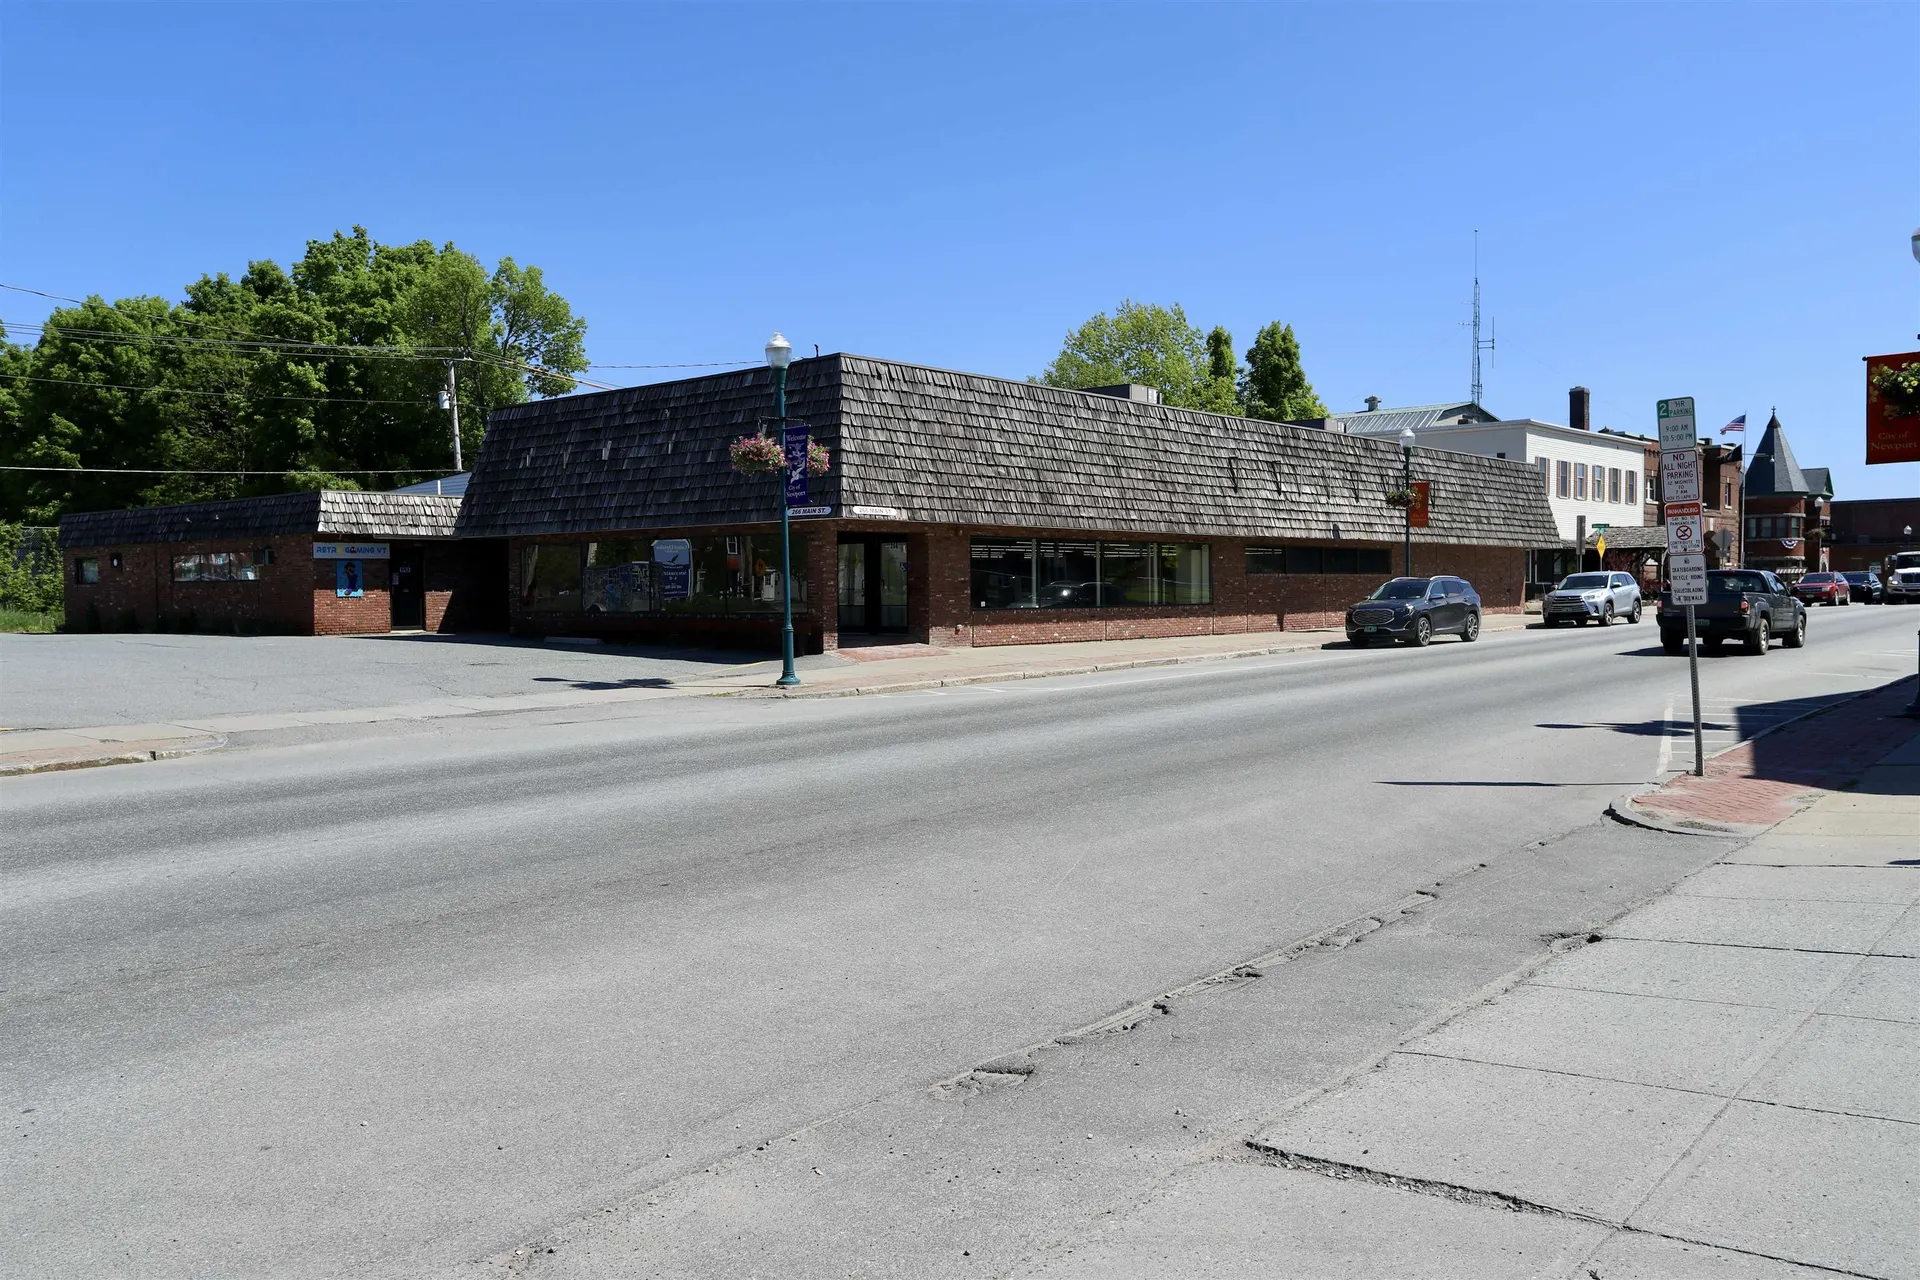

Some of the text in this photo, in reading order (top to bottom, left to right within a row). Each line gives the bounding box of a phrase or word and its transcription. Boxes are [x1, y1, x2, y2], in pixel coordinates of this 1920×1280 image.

[1659, 403, 1667, 416] 2
[1670, 408, 1693, 416] PARKING
[786, 434, 806, 442] Welcome
[1878, 431, 1909, 440] City of
[1870, 442, 1918, 452] Newport
[1672, 453, 1685, 461] NO
[1664, 461, 1696, 471] ALL NIGHT
[1666, 470, 1693, 480] PARKING
[786, 490, 806, 498] Newport
